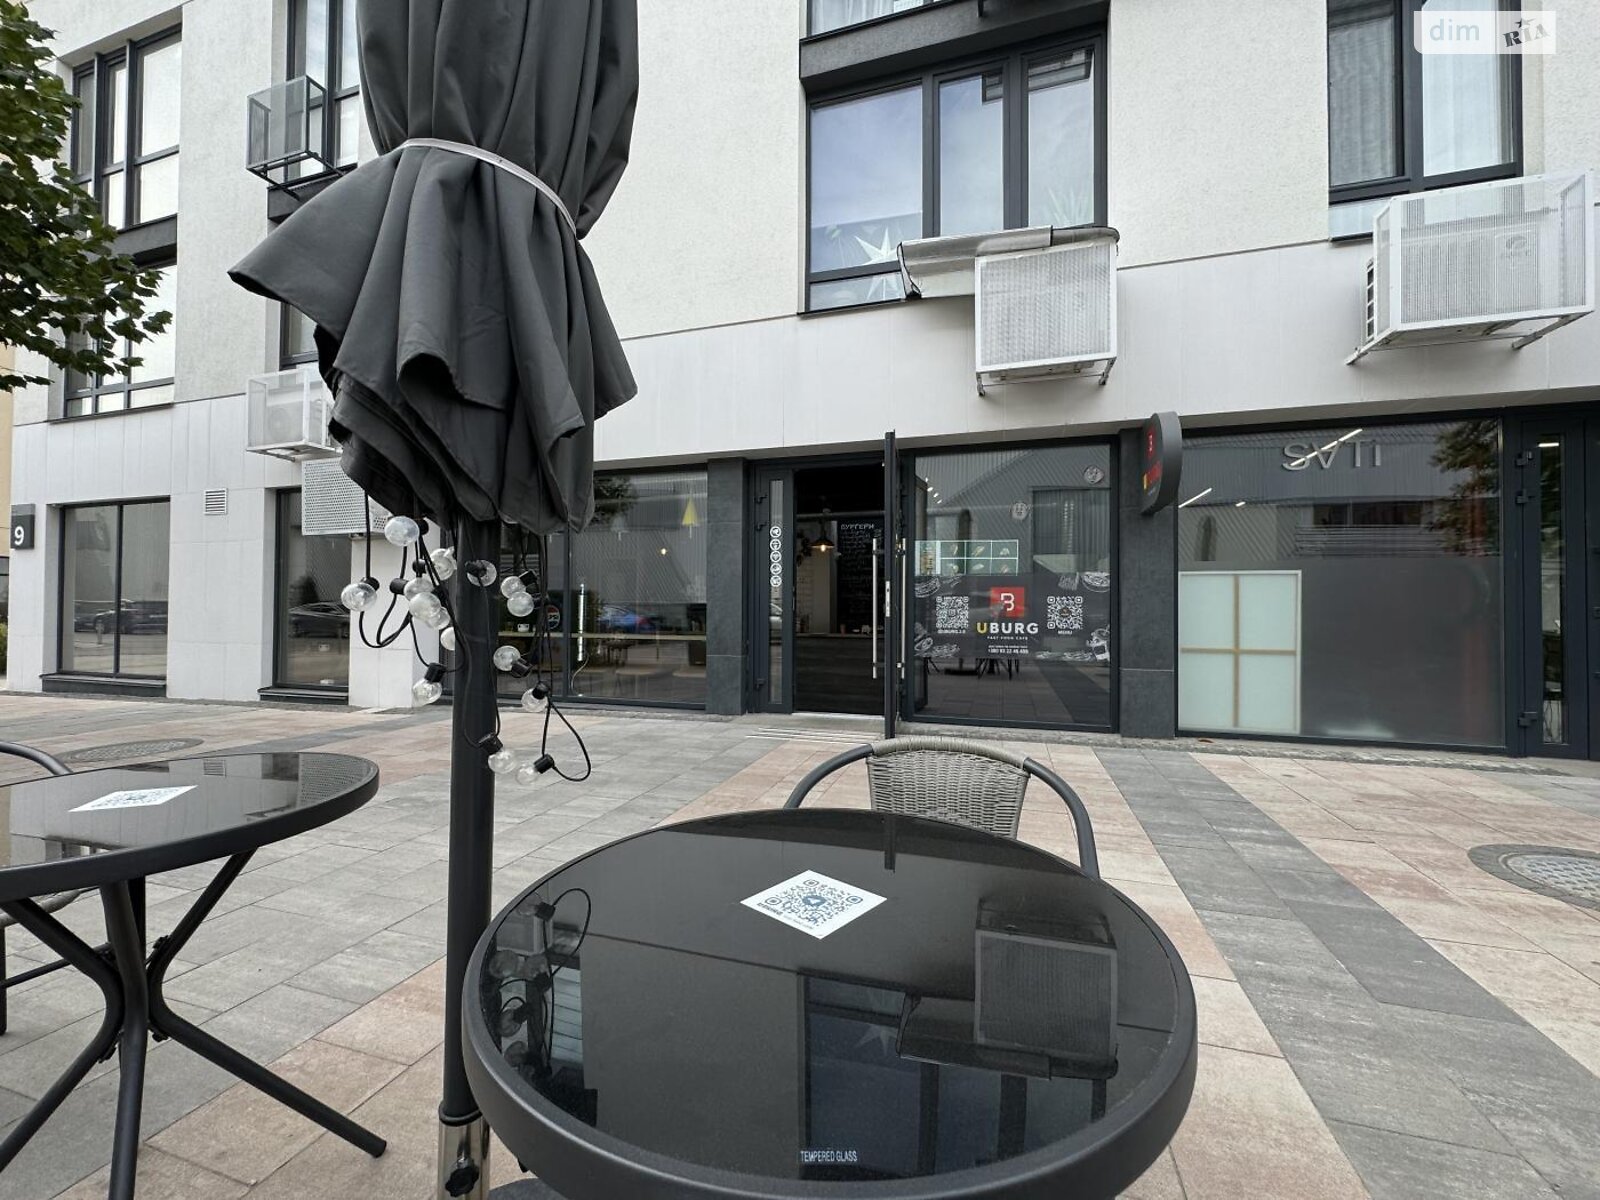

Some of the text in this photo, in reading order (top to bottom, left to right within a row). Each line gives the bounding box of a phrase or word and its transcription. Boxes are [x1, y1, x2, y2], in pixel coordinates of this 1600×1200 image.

[14, 525, 25, 546] 9
[976, 622, 1039, 634] UBURG
[800, 1150, 858, 1162] TEMPERED GLASS
